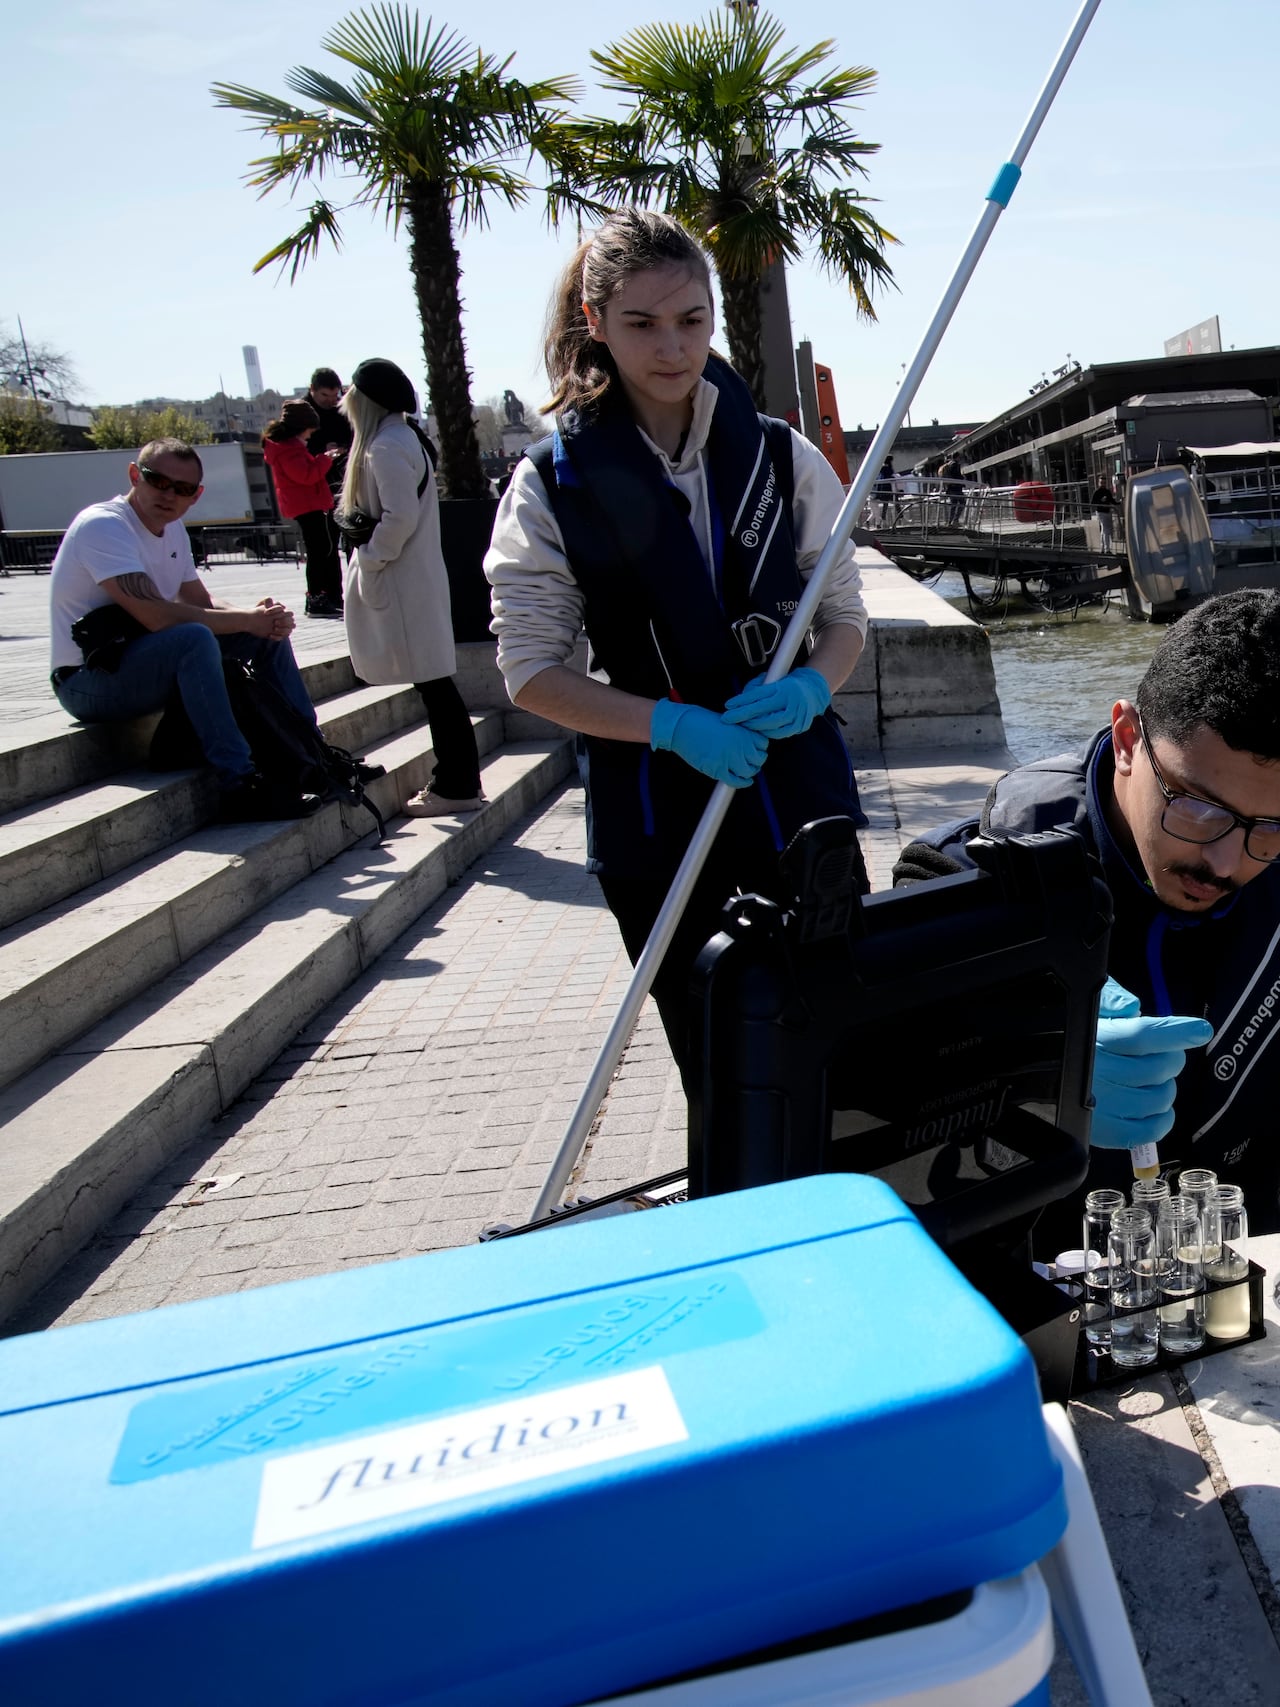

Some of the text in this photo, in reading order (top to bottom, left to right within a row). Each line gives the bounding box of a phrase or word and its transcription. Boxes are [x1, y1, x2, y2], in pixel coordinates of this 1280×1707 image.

[825, 432, 833, 443] 3
[903, 1084, 1013, 1150] fluidion
[493, 1292, 670, 1392] Isotherm
[215, 1339, 430, 1454] Isotherm
[296, 1399, 629, 1511] fluidion
